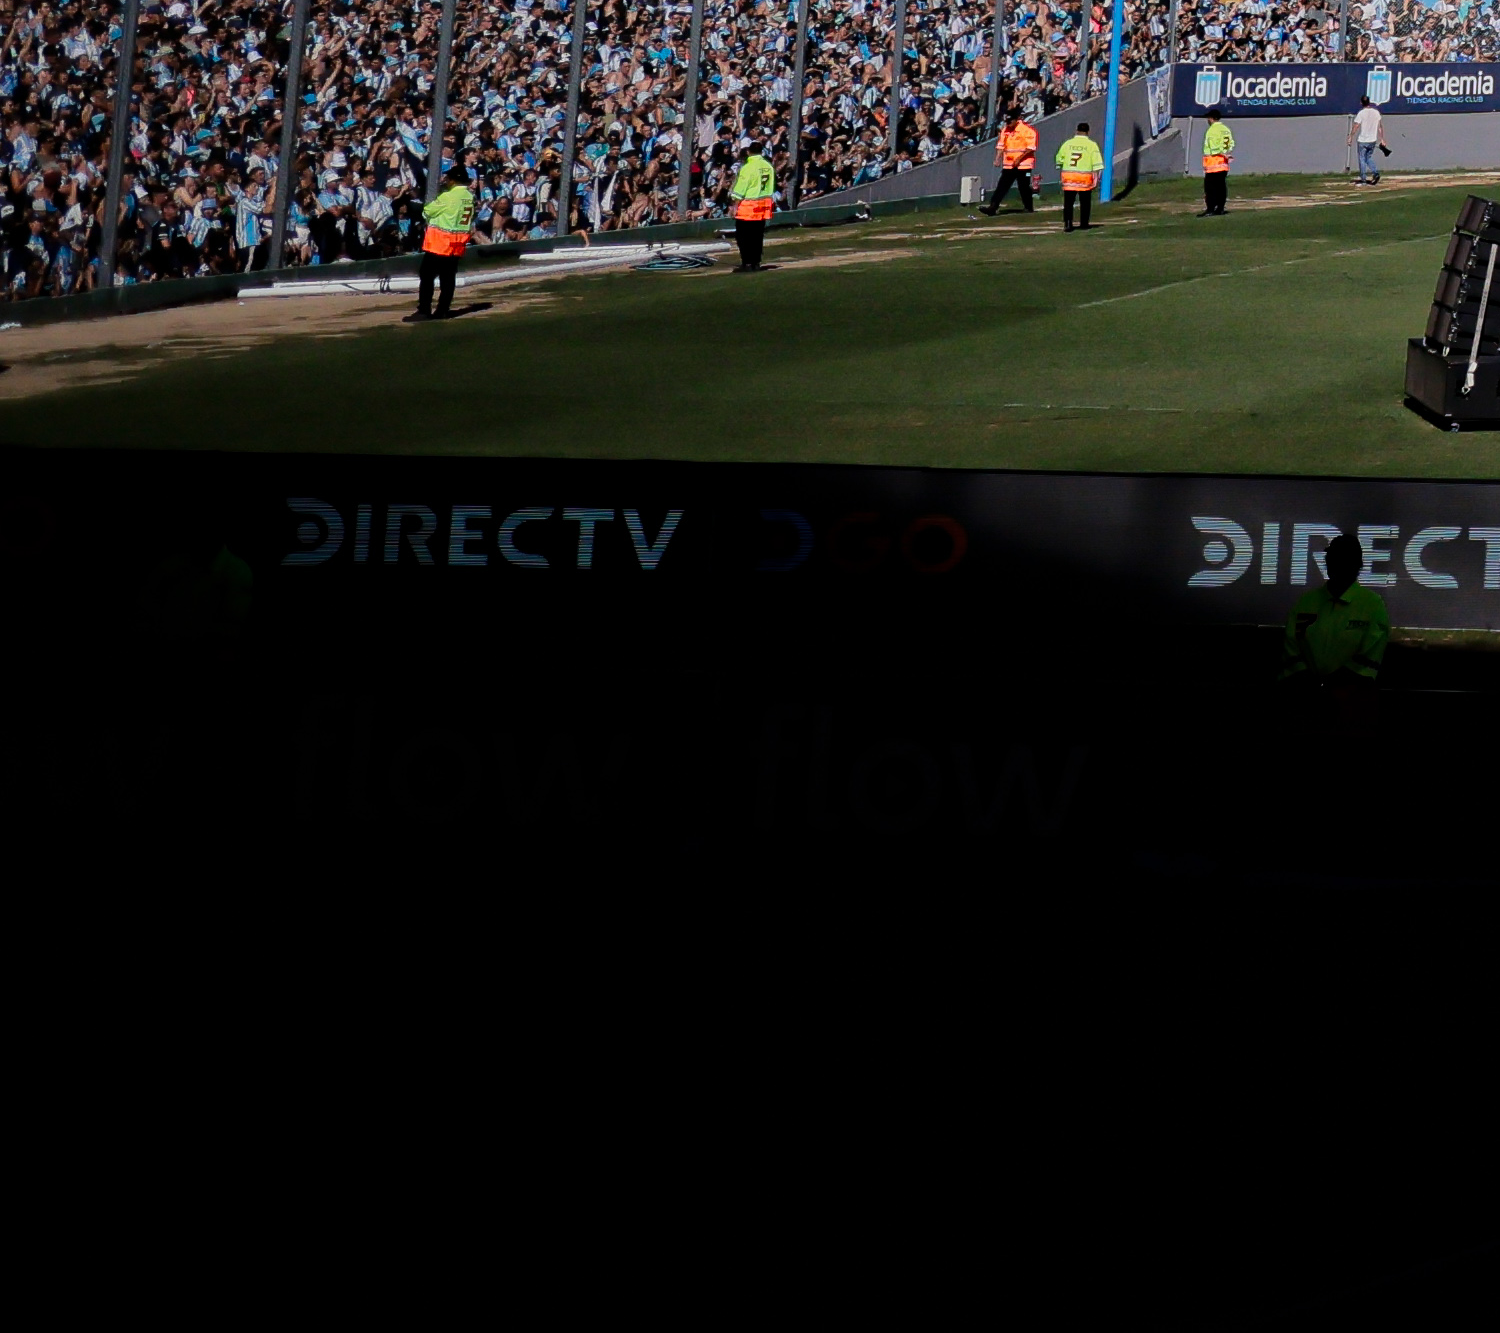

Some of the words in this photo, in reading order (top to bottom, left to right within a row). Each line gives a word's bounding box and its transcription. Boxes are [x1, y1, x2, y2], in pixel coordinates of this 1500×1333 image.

[1226, 71, 1327, 98] locademia
[1396, 70, 1494, 97] locademia
[281, 497, 685, 572] DIRECTV
